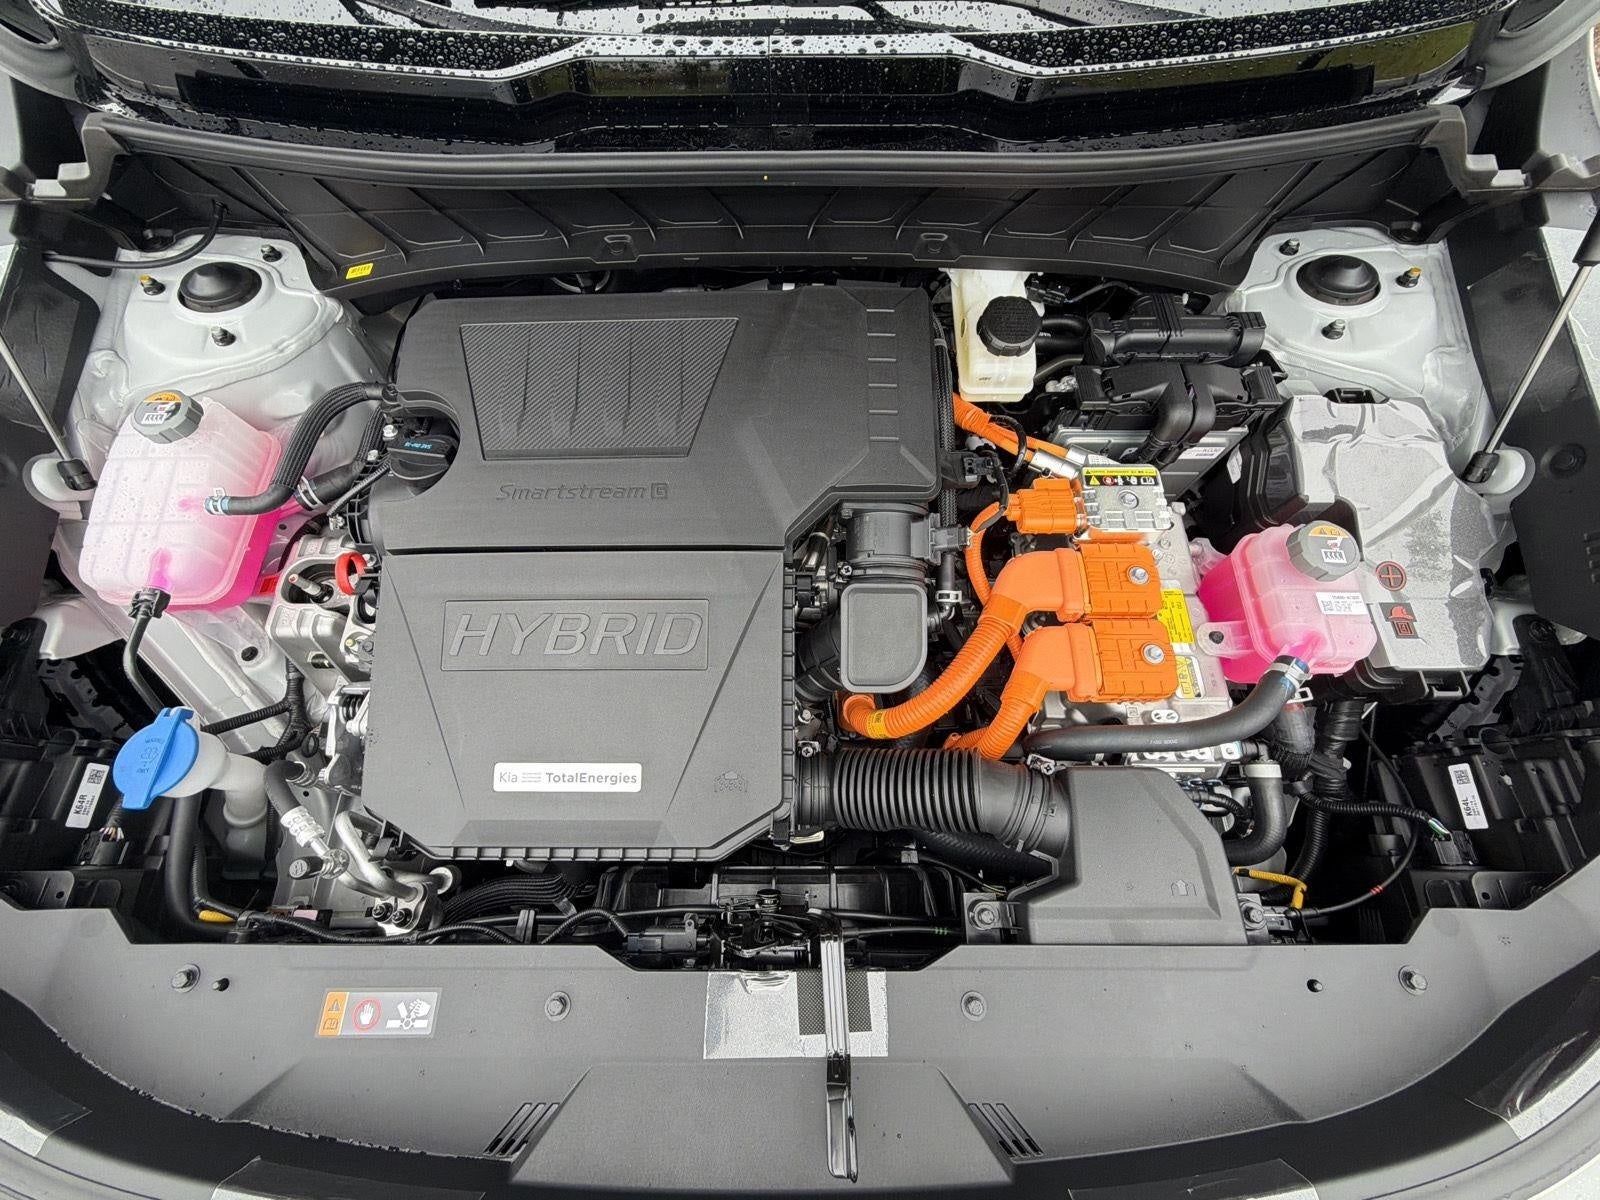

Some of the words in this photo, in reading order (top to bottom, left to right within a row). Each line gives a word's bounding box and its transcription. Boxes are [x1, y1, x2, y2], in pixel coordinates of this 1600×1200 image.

[496, 484, 646, 500] Smartstream
[449, 612, 704, 656] HYBRID
[499, 771, 518, 783] Kia
[546, 772, 637, 785] TotalEnergies
[73, 794, 88, 815] K64R
[1461, 797, 1473, 816] K64L
